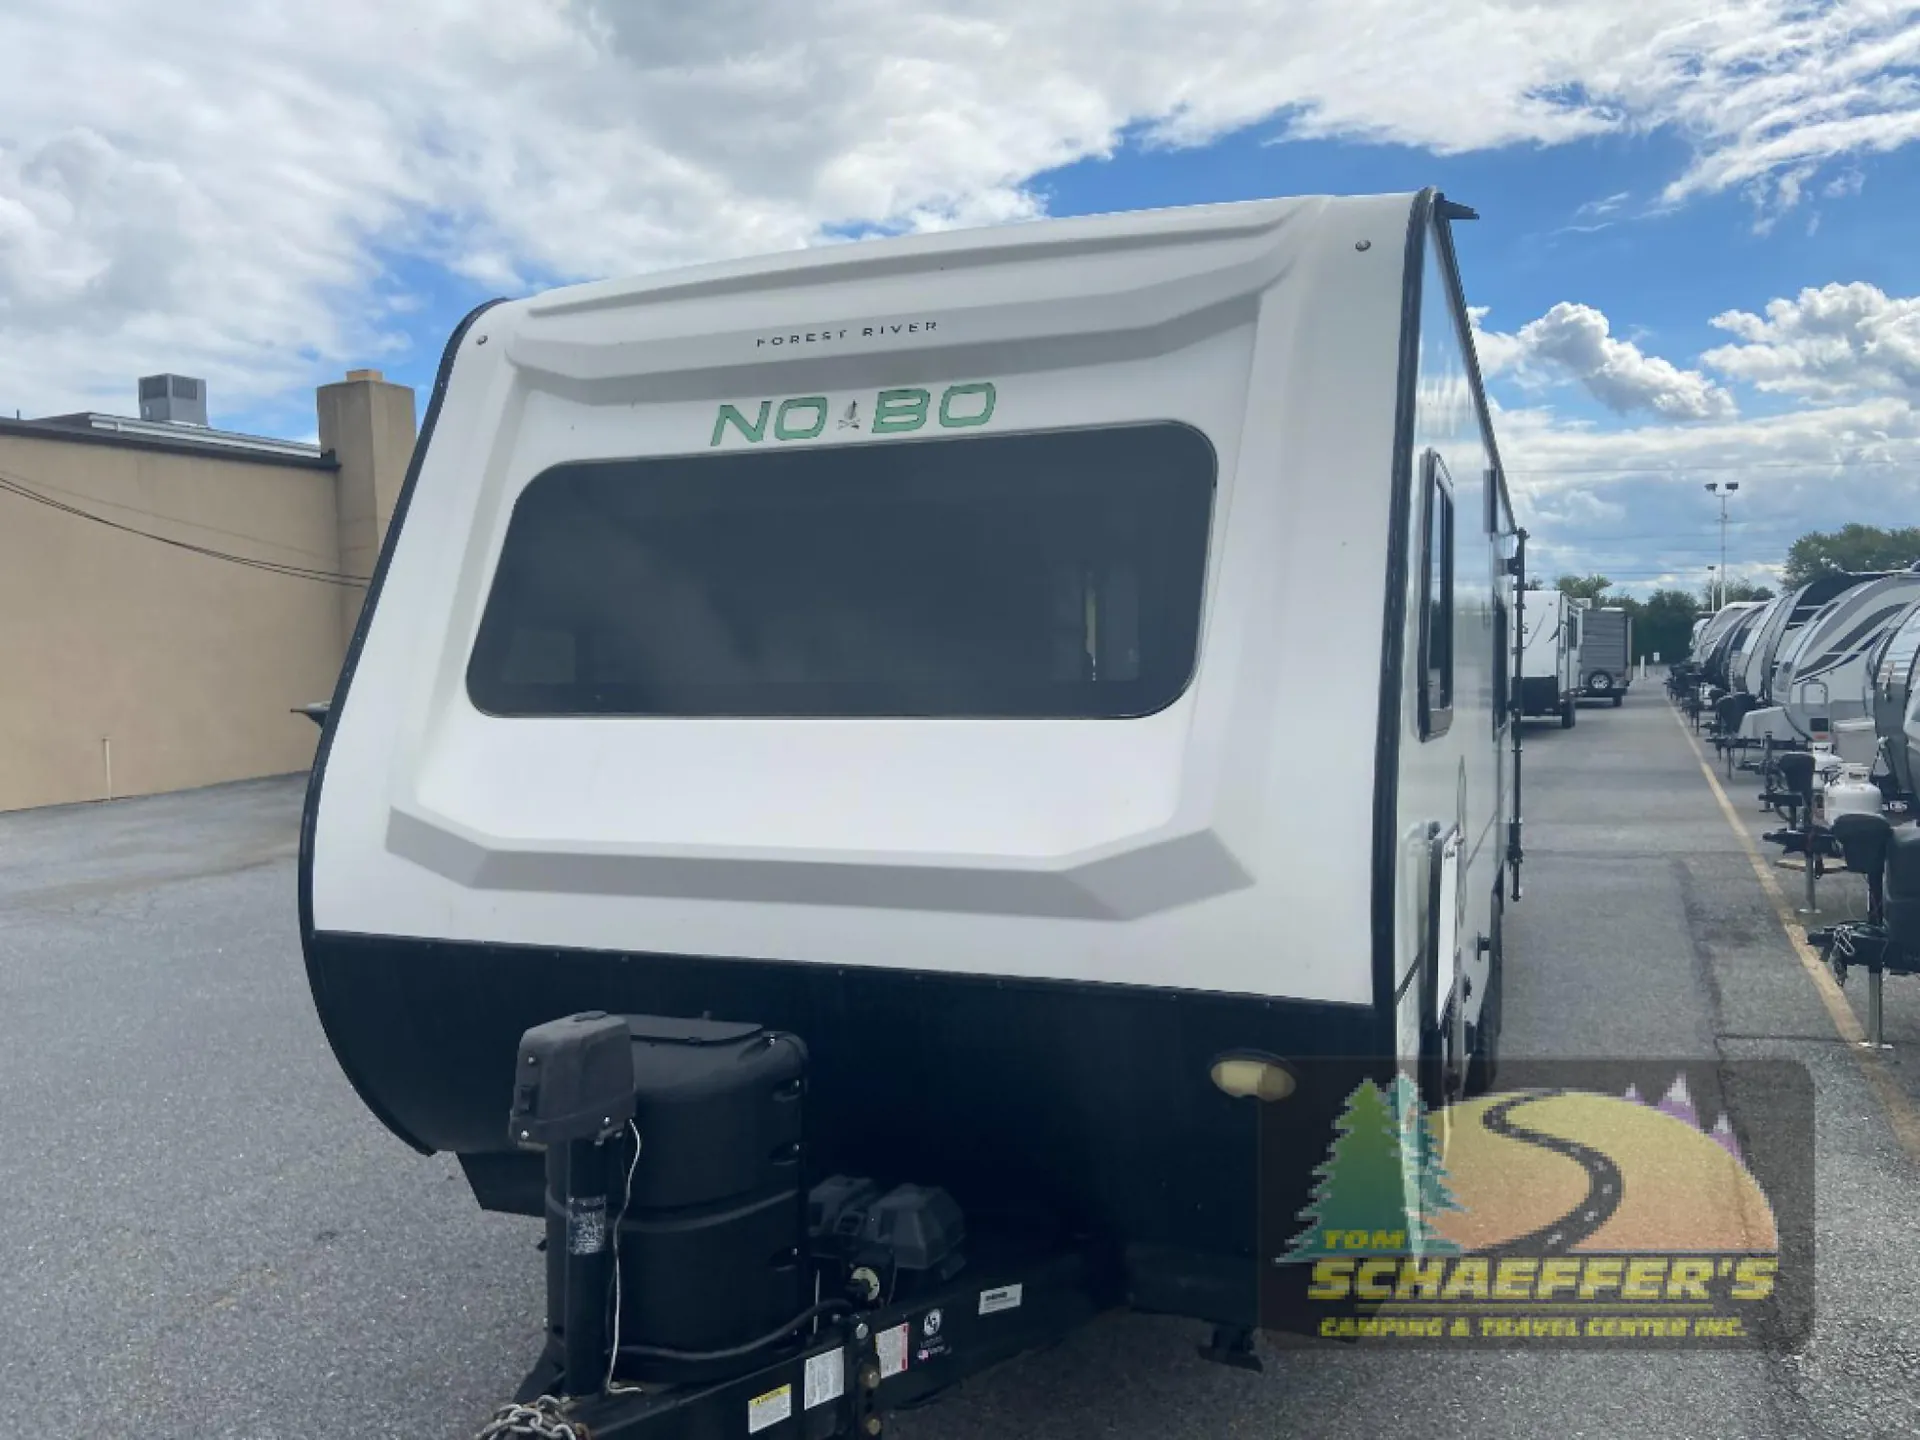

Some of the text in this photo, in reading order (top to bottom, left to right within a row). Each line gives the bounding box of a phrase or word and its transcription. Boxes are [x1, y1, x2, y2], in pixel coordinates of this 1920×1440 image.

[756, 321, 938, 348] FOREST RIVER
[710, 381, 997, 447] NO BO
